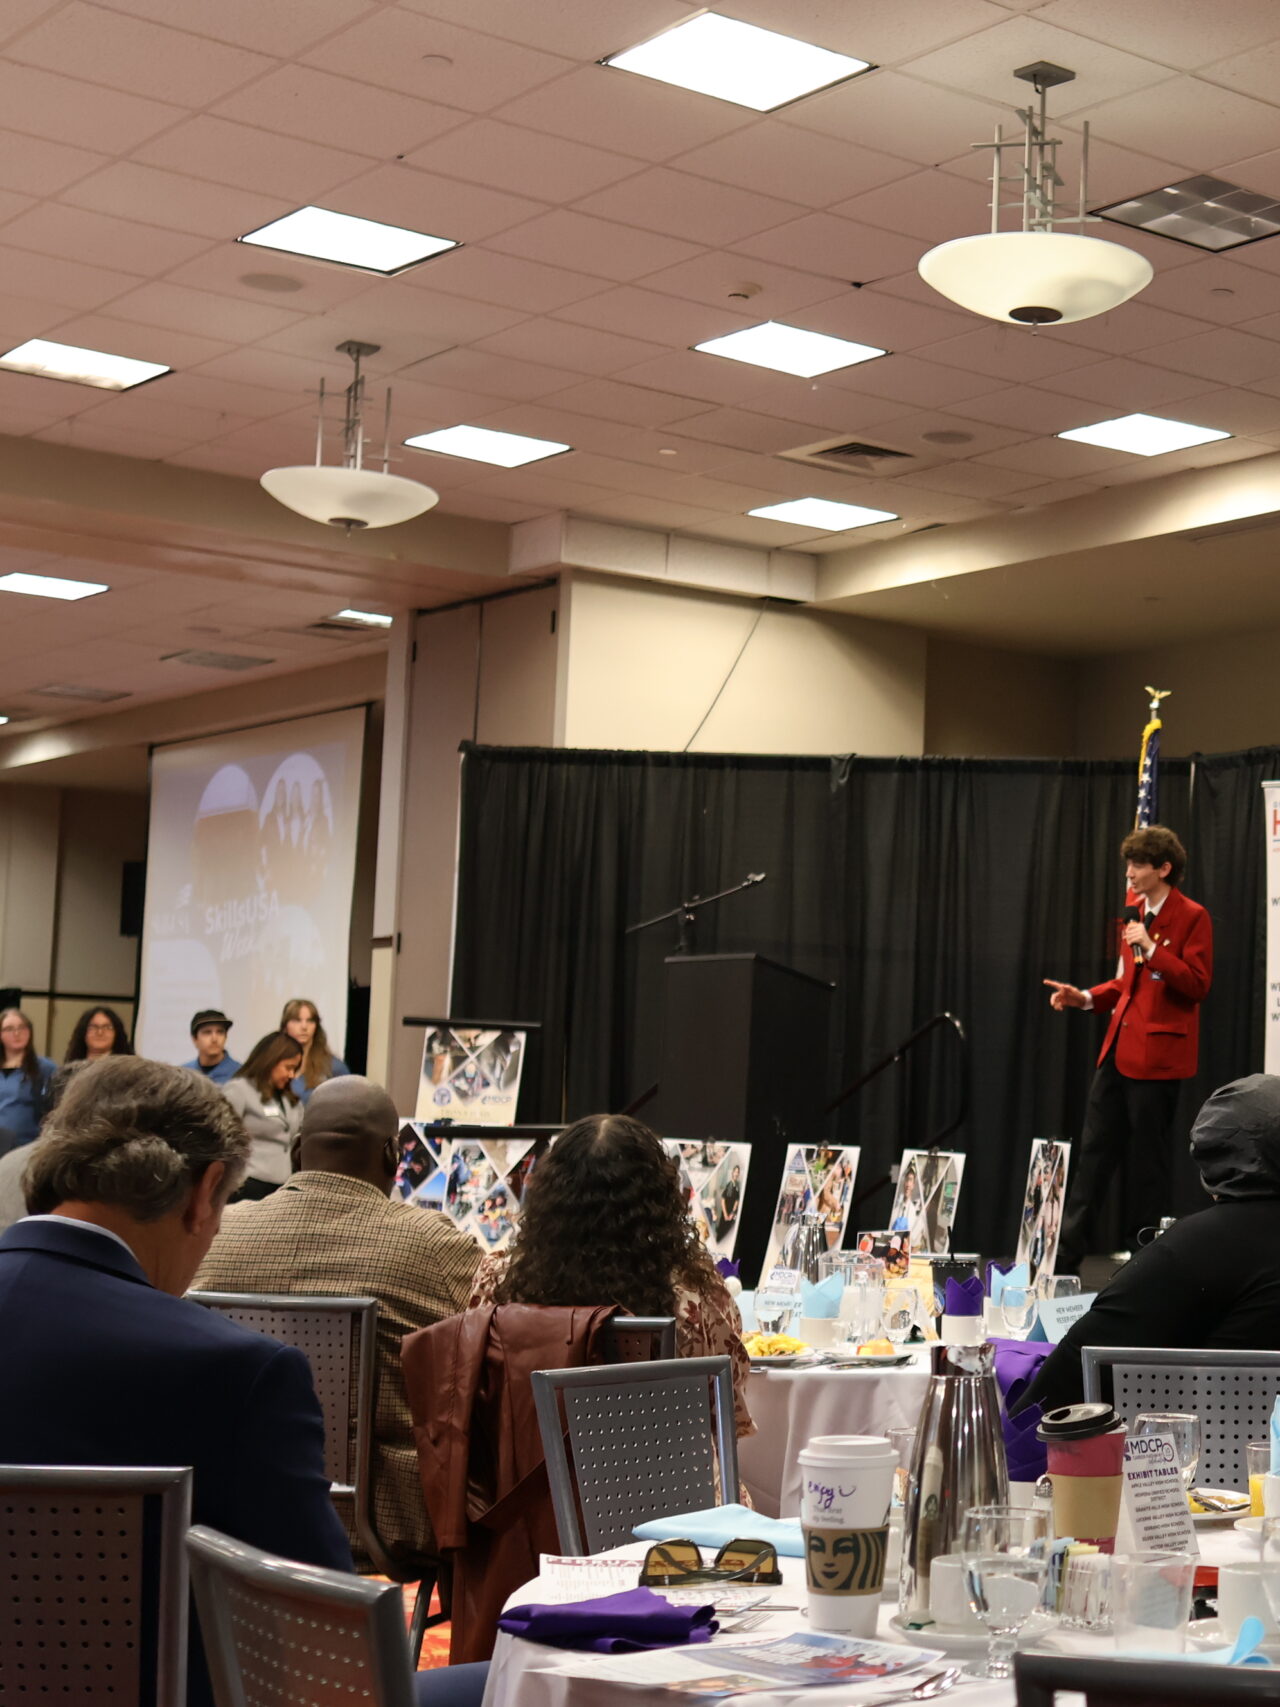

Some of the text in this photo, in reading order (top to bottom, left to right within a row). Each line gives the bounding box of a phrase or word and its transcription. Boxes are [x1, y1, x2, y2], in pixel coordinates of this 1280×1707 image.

[1130, 1438, 1163, 1454] MDCP
[1127, 1467, 1179, 1481] EXHIBIT TABLES
